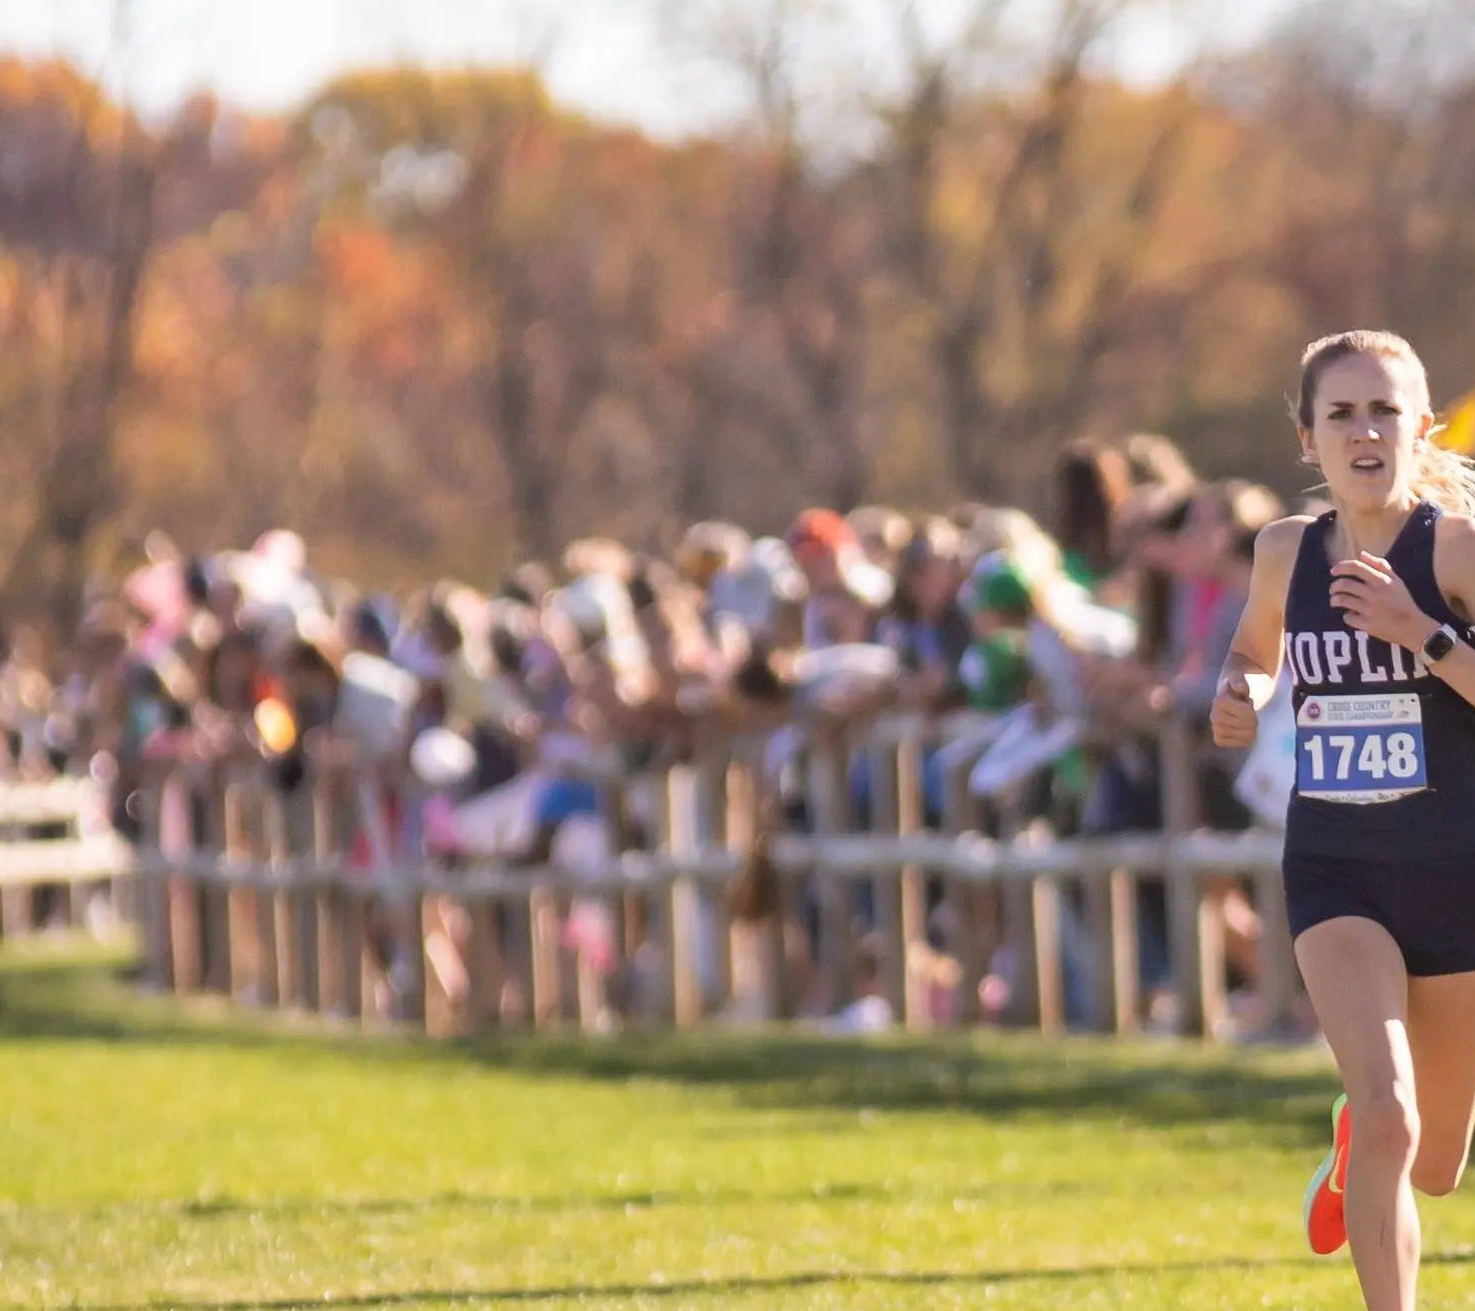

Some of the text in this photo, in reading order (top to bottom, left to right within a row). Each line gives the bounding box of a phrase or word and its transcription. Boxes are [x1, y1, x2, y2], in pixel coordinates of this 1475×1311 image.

[1327, 701, 1351, 712] CROSS
[1353, 699, 1392, 711] COUNTRY
[1303, 732, 1418, 780] 1748
